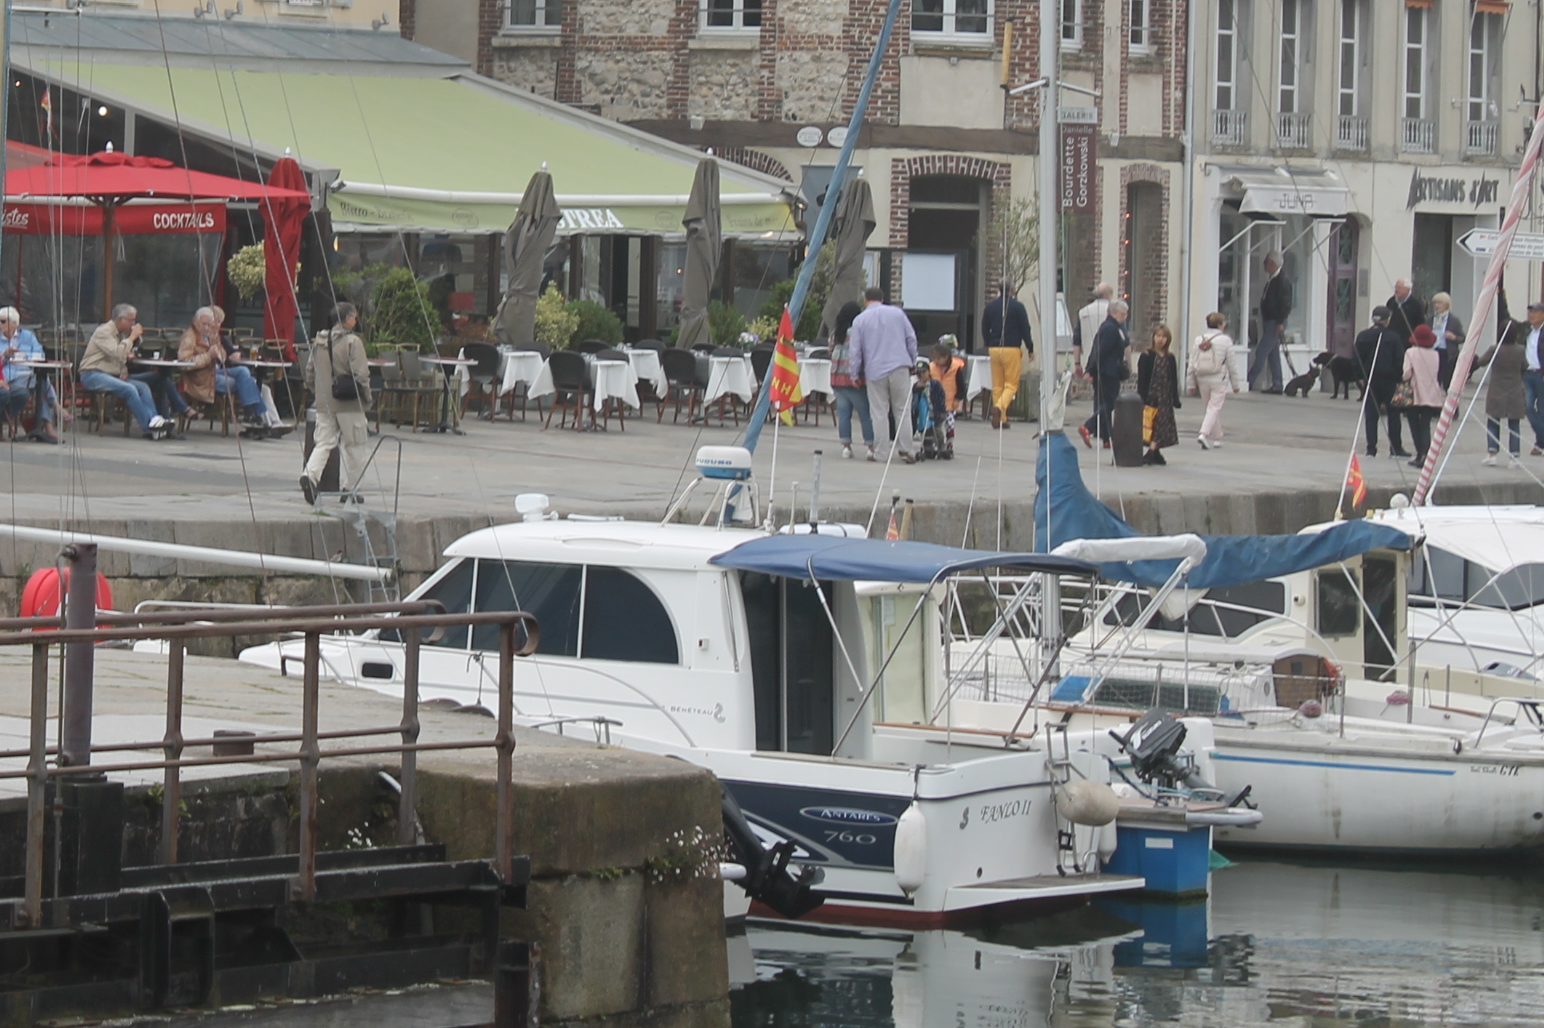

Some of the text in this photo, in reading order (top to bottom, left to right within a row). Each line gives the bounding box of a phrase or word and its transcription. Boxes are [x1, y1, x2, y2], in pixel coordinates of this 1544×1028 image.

[1062, 136, 1075, 207] Bourdette
[1076, 136, 1089, 207] Gorzkowski
[1406, 166, 1466, 211] ARTISANS
[153, 212, 215, 229] COCKTAILS
[824, 830, 876, 845] 760
